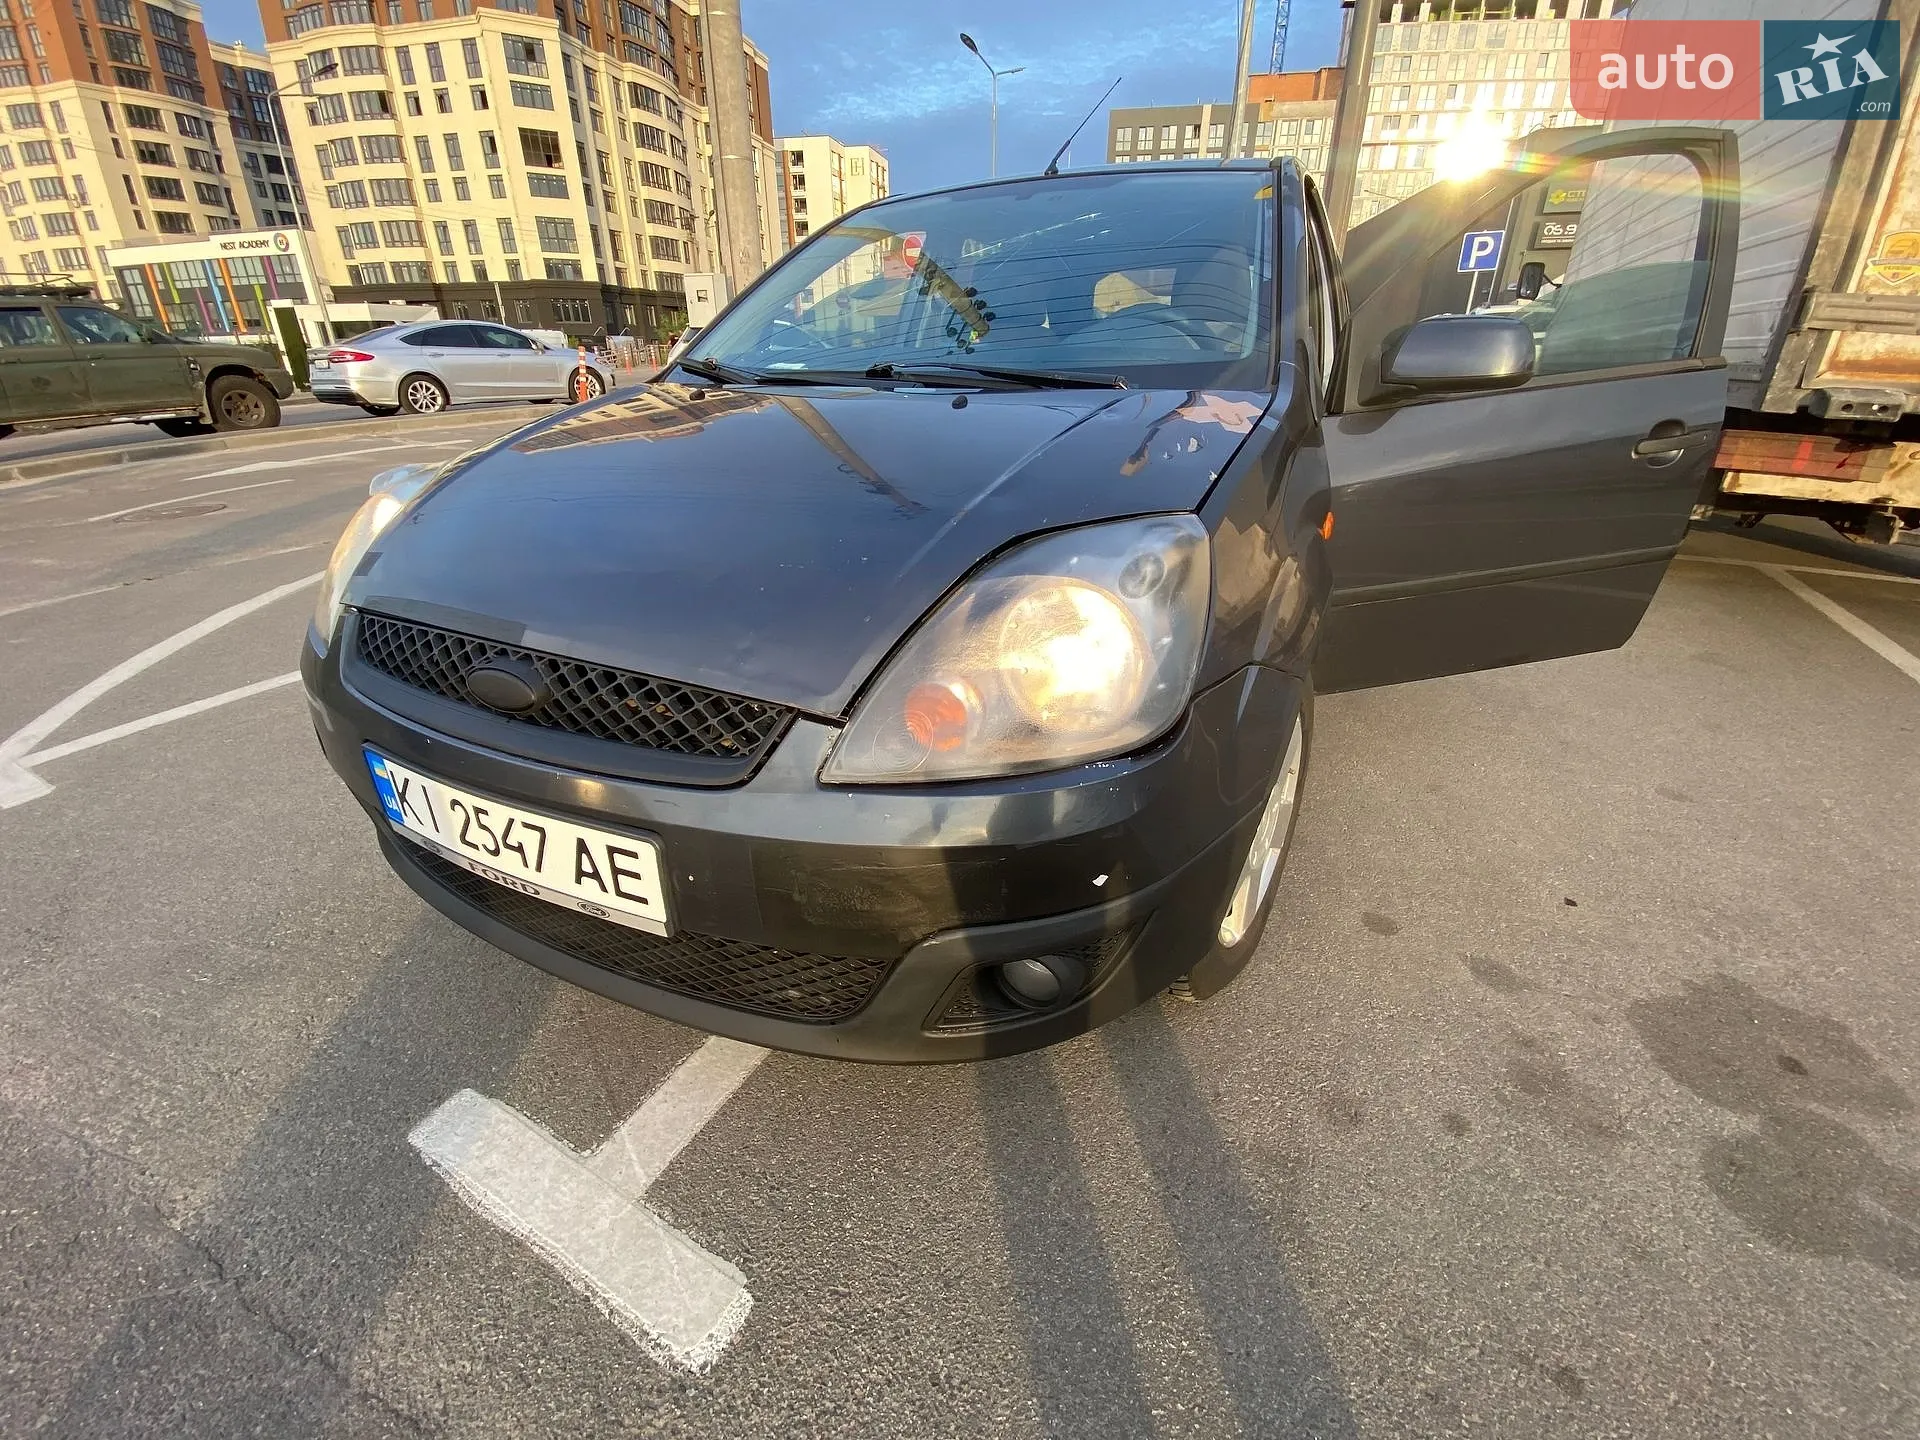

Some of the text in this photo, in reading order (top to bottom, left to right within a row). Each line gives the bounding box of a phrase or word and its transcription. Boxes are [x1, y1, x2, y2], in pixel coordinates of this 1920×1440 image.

[220, 242, 236, 250] NEST
[239, 240, 269, 249] ACADEMY
[1469, 236, 1494, 268] P
[384, 796, 399, 812] UA
[390, 771, 649, 905] KI 2547 AE
[467, 862, 541, 896] FORD
